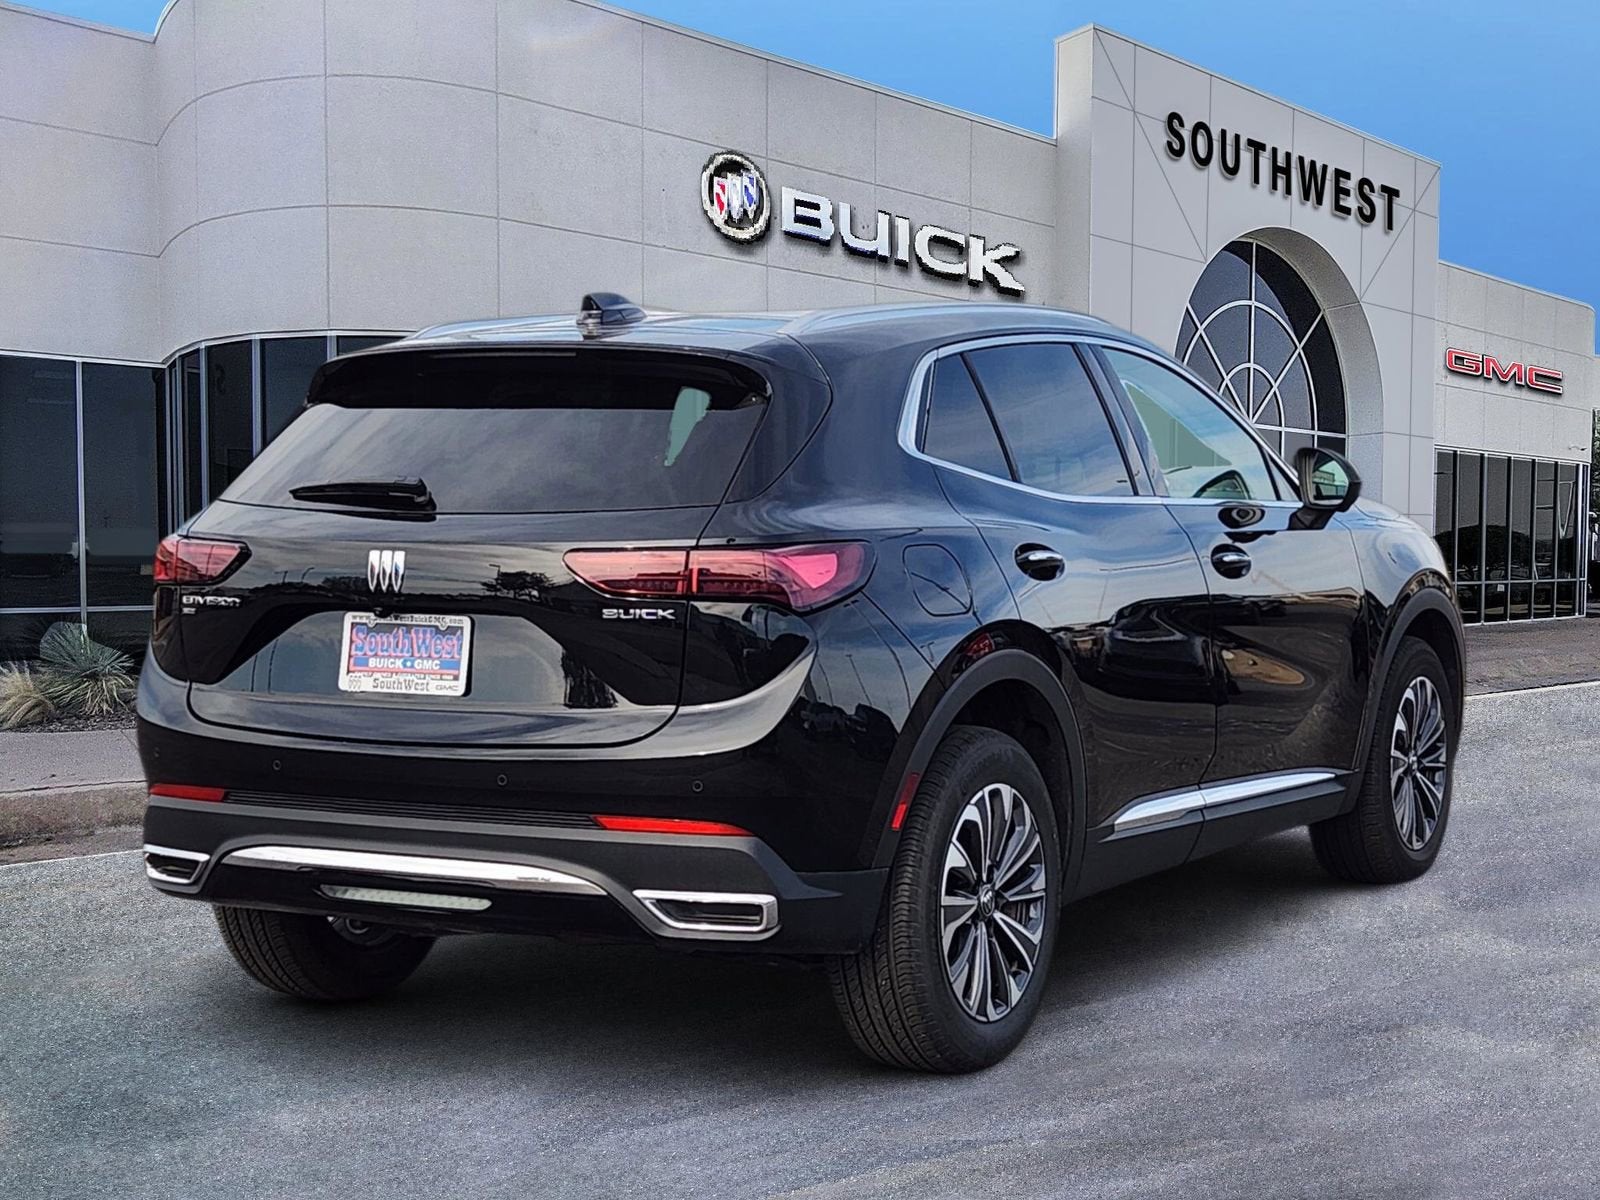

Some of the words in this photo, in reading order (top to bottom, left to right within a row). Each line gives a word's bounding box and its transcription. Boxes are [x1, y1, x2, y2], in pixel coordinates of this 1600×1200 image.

[1166, 111, 1401, 230] SOUTHWEST
[780, 186, 1025, 295] BUICK
[1445, 347, 1563, 395] GMC
[602, 609, 675, 619] BUICK
[351, 625, 463, 658] SouthWest
[369, 658, 403, 668] BUICK
[414, 659, 441, 669] GMC
[372, 678, 430, 692] SouthWest
[435, 684, 459, 692] GMC
